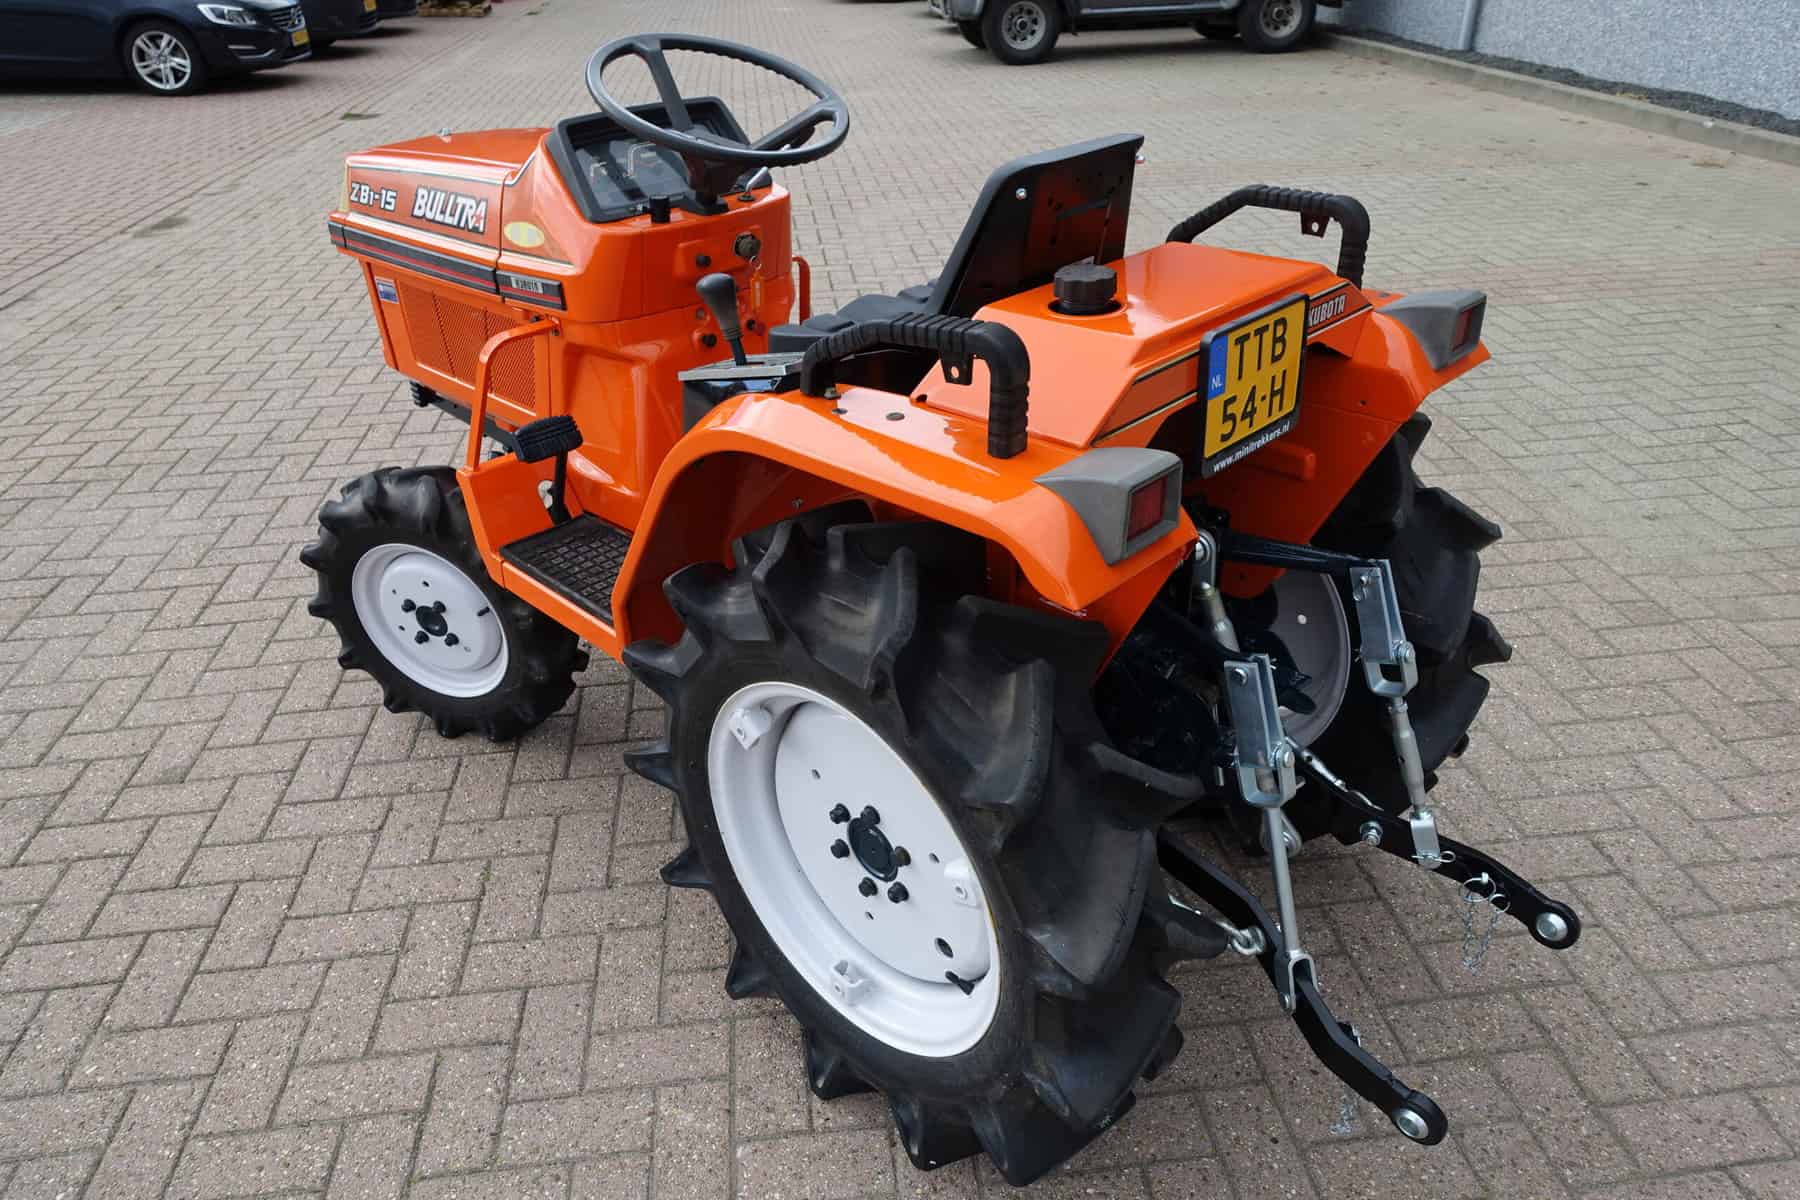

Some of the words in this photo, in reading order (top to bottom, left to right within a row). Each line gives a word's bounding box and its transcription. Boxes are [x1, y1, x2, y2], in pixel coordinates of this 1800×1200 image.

[412, 187, 487, 234] BULLTRA
[1235, 318, 1288, 381] TTB
[1212, 374, 1223, 391] NL
[1220, 370, 1286, 442] 54-H
